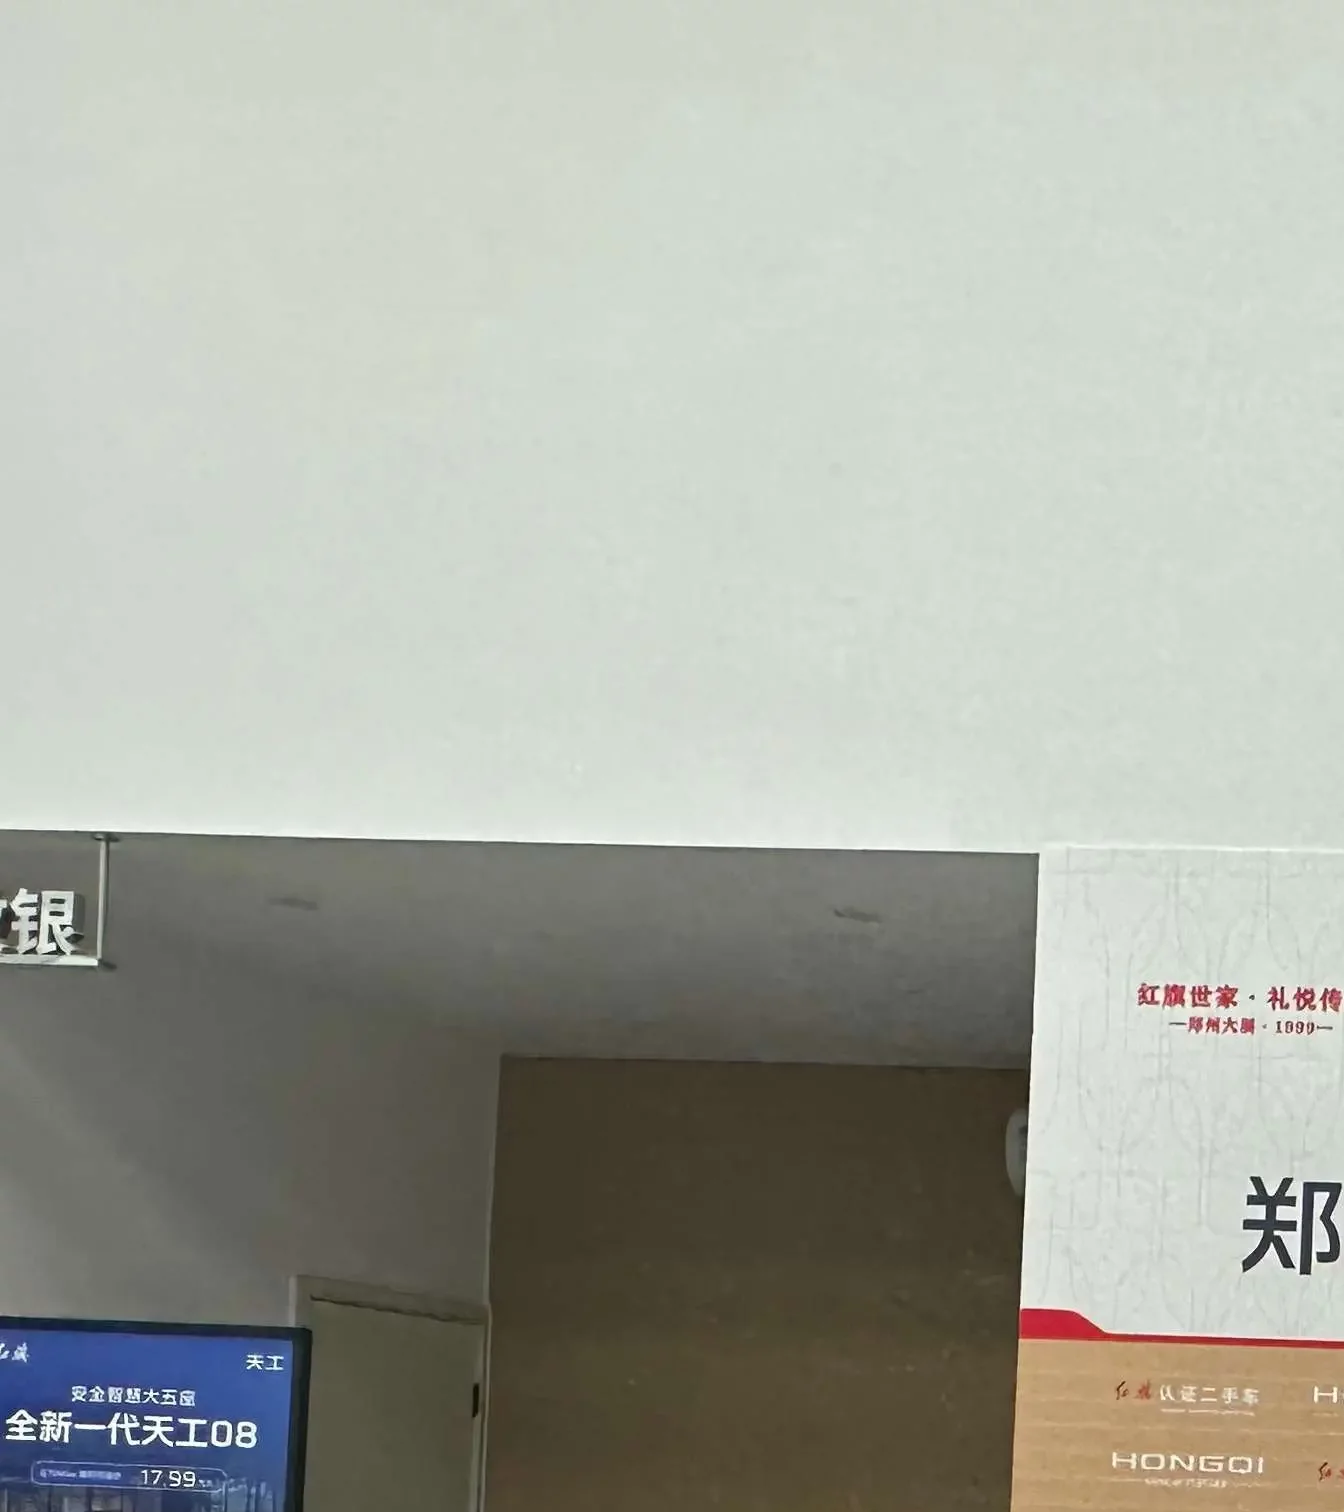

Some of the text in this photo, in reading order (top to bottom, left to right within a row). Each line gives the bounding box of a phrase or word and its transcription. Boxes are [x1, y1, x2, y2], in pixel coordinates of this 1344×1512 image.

[0, 887, 76, 956] 银
[246, 1354, 285, 1371] 天工
[5, 1409, 258, 1449] 全新一代天工08
[1112, 1452, 1264, 1475] HONGQI
[141, 1469, 196, 1488] 17.99
